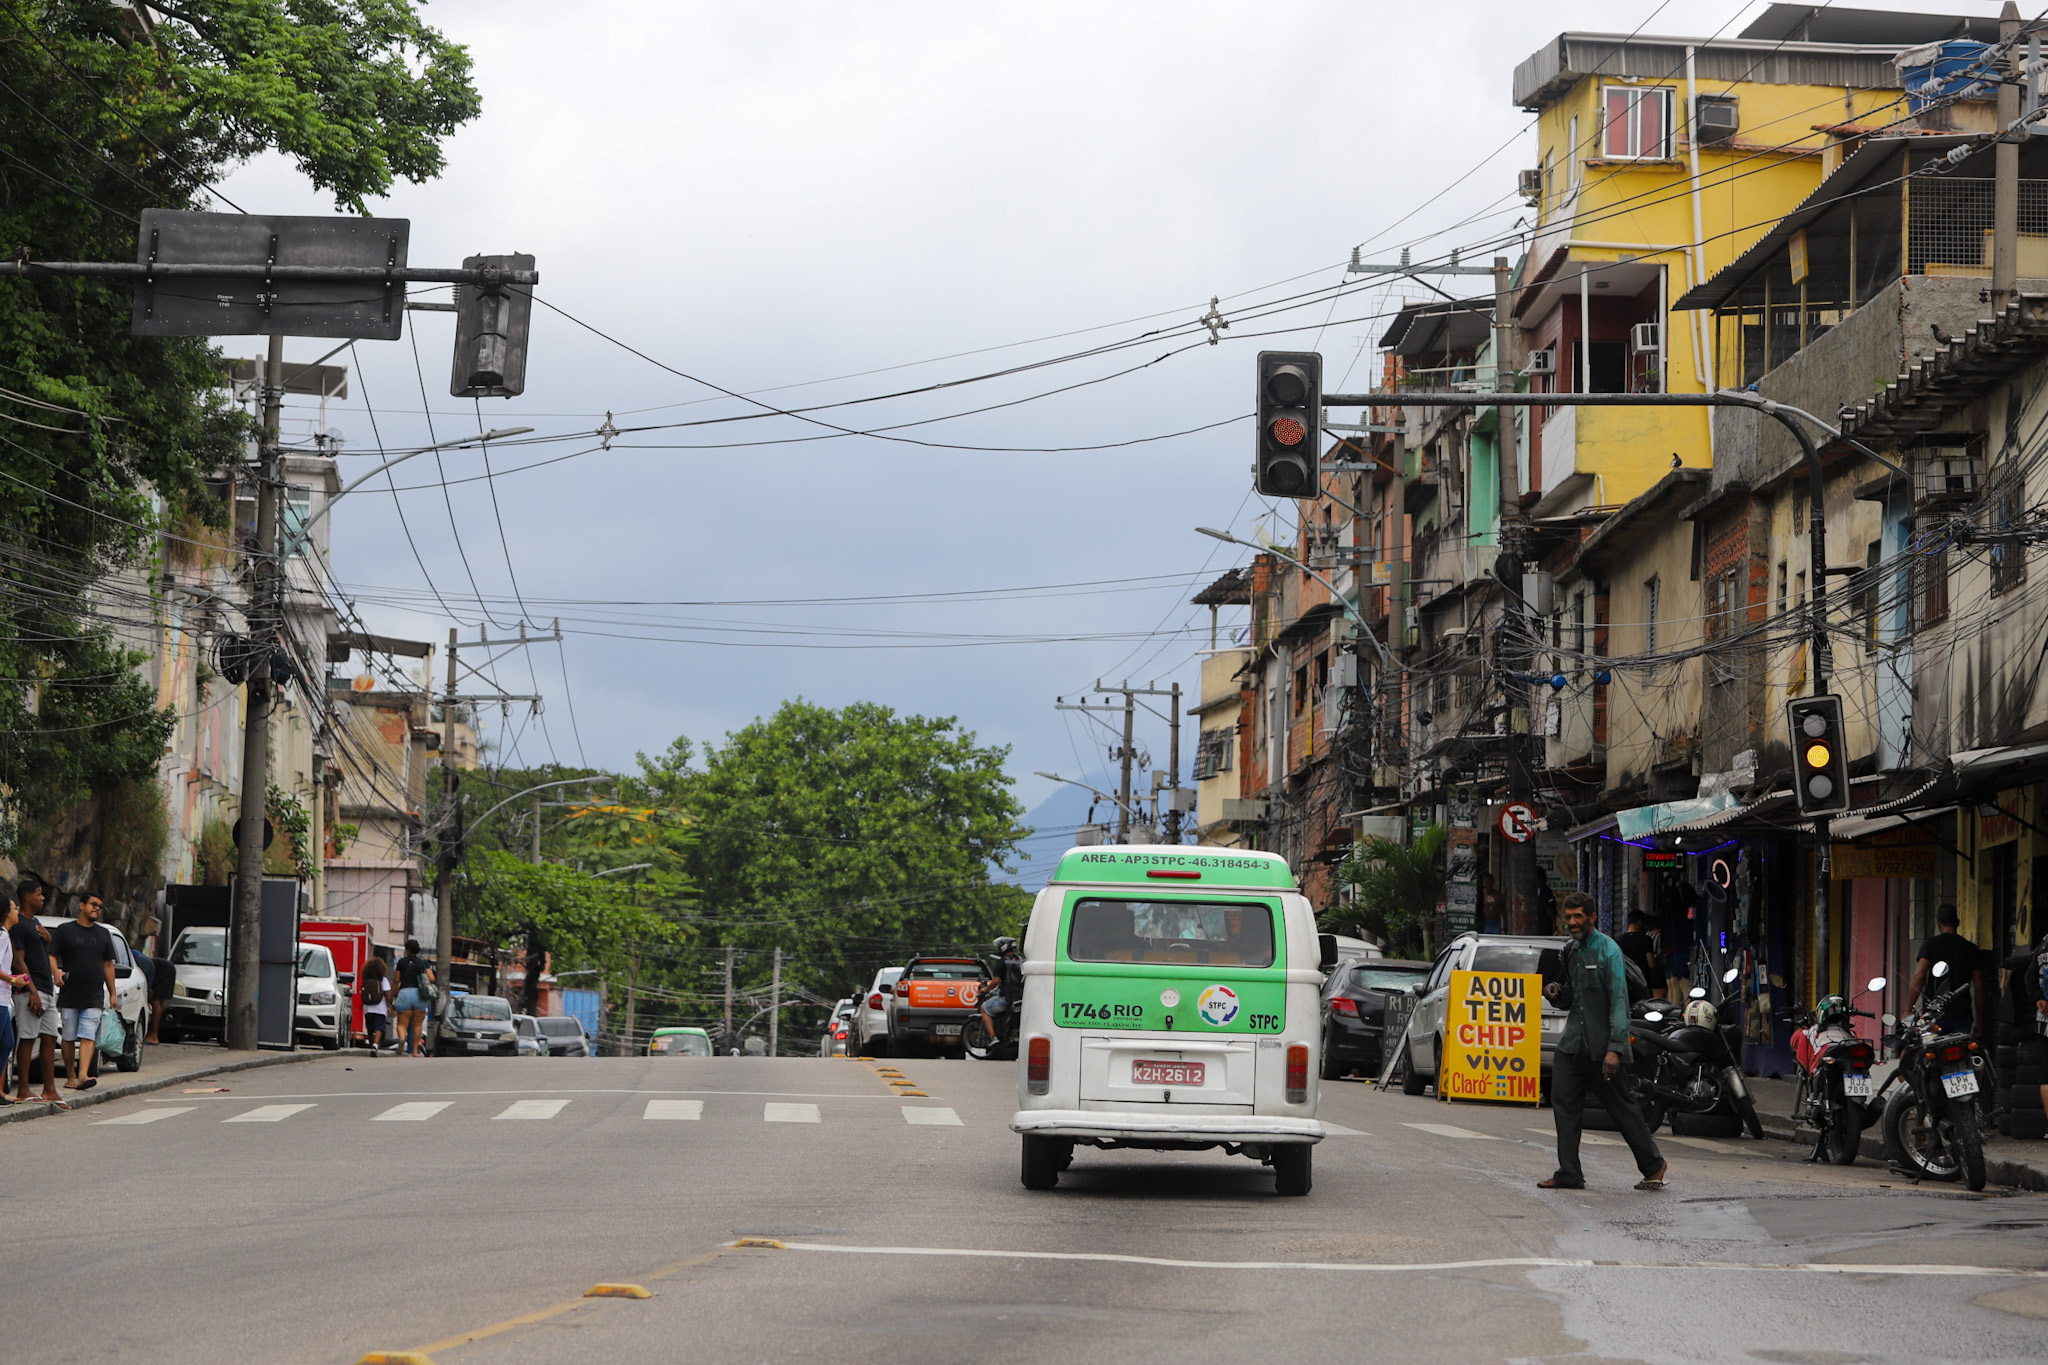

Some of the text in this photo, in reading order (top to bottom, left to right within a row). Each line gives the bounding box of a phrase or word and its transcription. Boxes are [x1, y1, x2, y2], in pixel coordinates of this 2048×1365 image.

[1081, 854, 1117, 864] AREA
[1467, 976, 1525, 1001] AQUI
[1061, 1002, 1143, 1020] 1746 RIO
[1208, 1002, 1227, 1010] STPC
[1462, 1000, 1526, 1026] TEM
[1249, 1014, 1279, 1030] STPC
[1457, 1024, 1525, 1050] CHIP
[1466, 1049, 1526, 1072] vivo
[1452, 1072, 1537, 1098] Claro TIM
[1848, 1086, 1870, 1094] 7B98
[1950, 1083, 1975, 1094] 4F92
